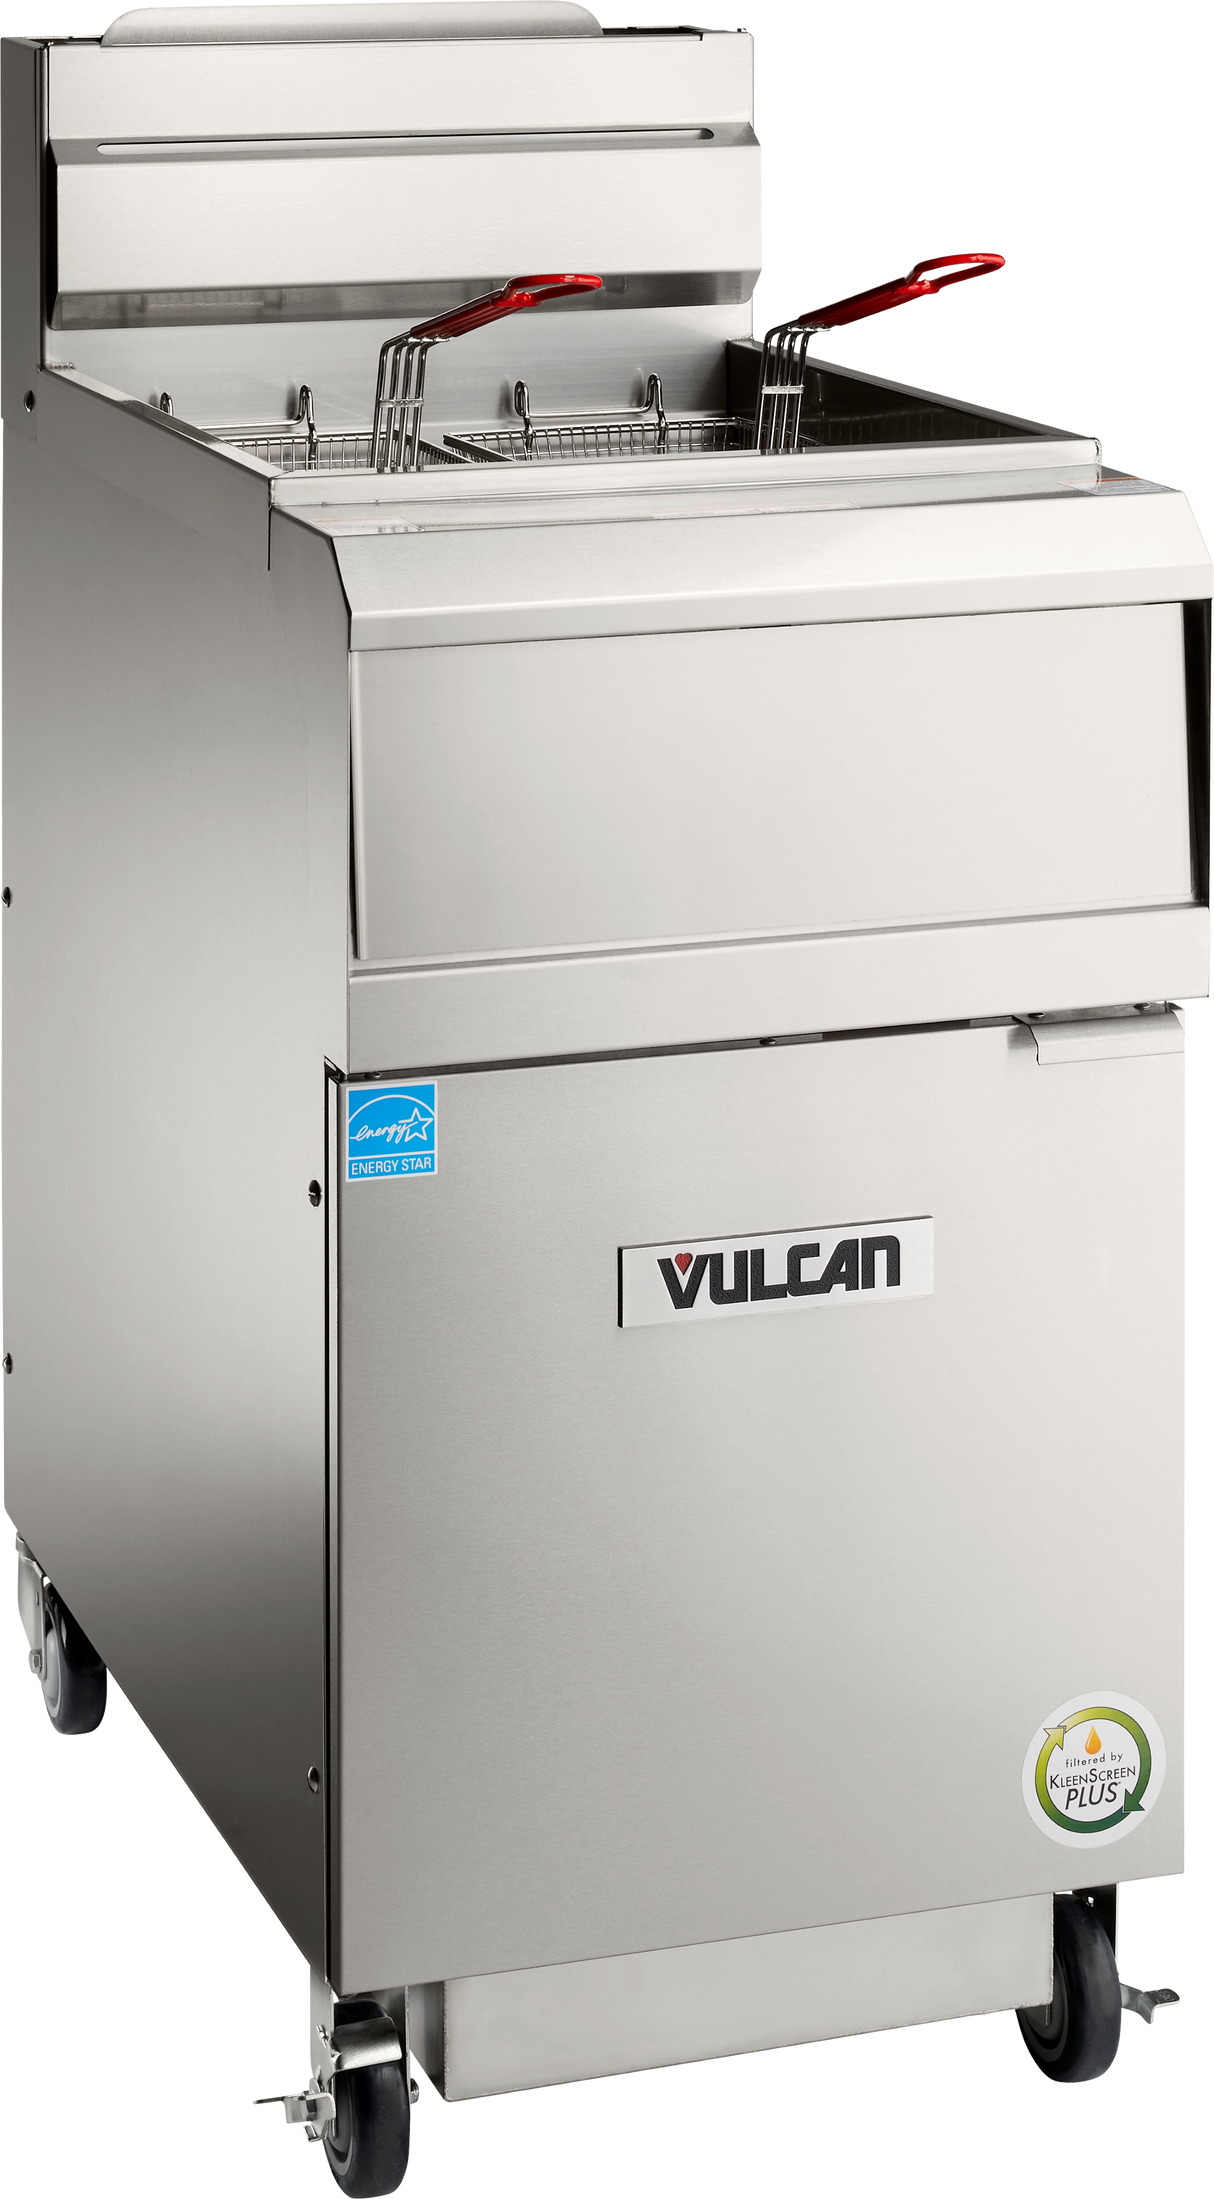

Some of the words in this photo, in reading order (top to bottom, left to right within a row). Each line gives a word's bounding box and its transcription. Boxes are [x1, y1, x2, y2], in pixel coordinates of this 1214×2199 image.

[350, 1121, 415, 1144] energy
[351, 1160, 399, 1175] ENERGY
[401, 1157, 432, 1171] STAR
[656, 1235, 901, 1310] VULCAN
[1065, 1753, 1106, 1768] filtered
[1110, 1752, 1124, 1763] by
